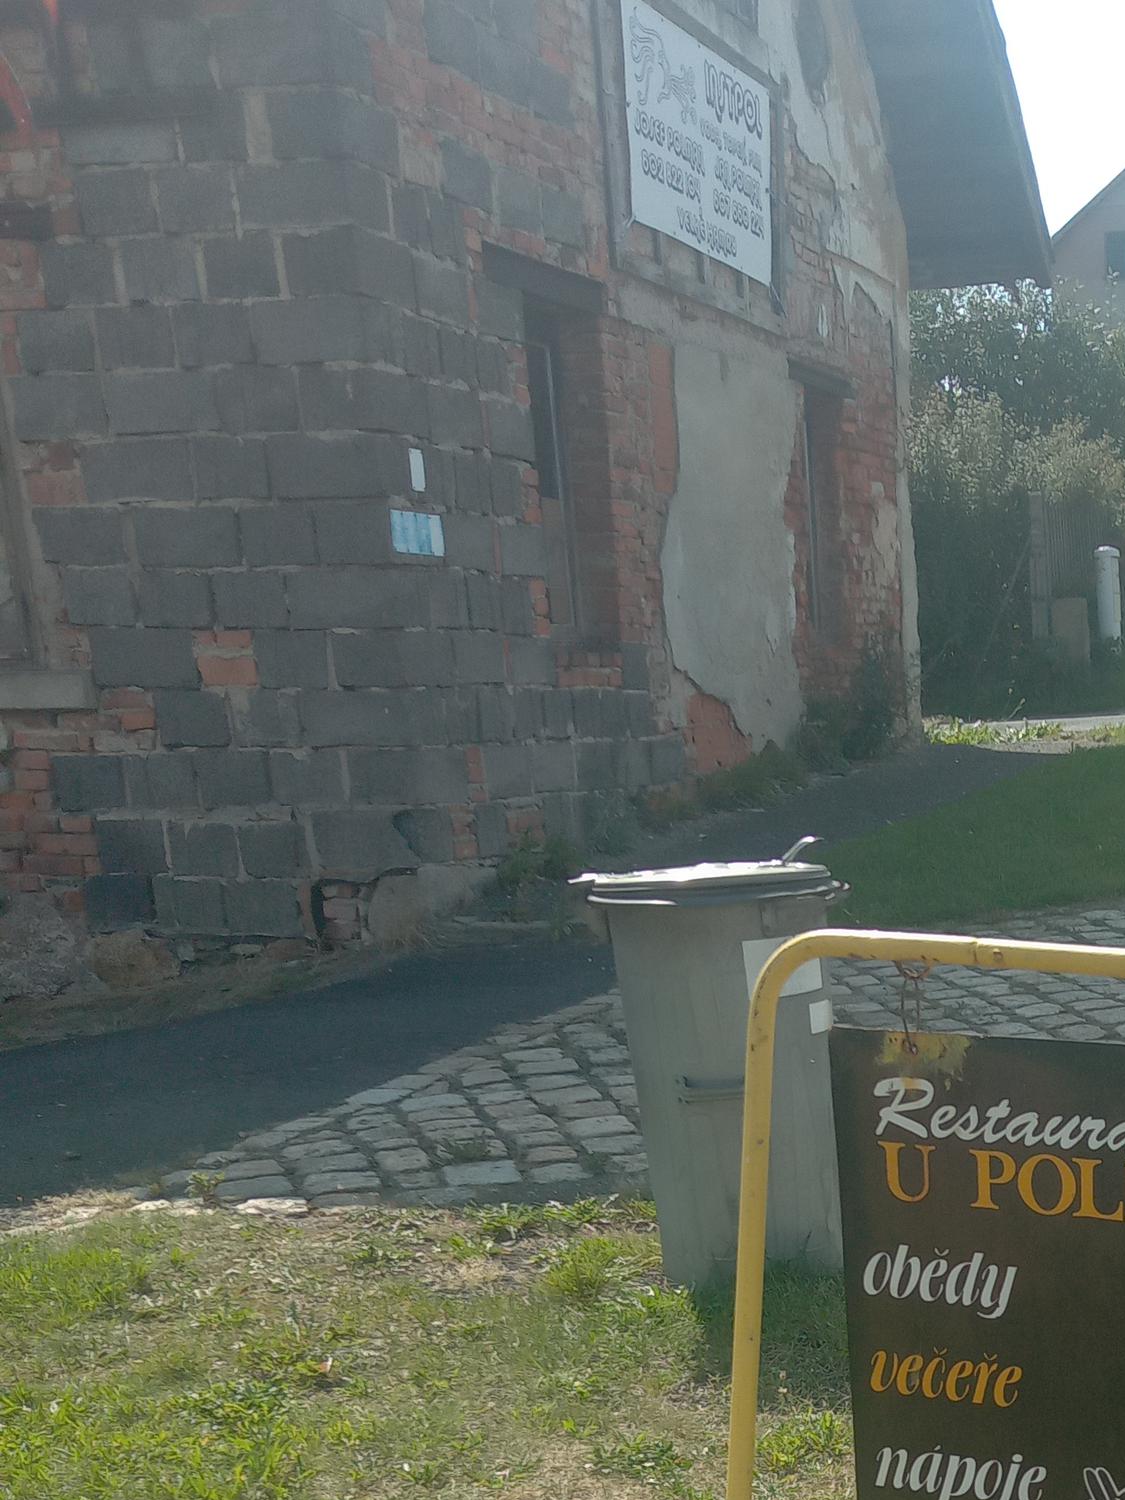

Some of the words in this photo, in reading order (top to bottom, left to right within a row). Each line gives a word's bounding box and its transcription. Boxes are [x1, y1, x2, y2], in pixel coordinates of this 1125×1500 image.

[634, 107, 665, 147] JOSEF
[641, 148, 665, 184] 602
[877, 1141, 936, 1203] U
[862, 1244, 1018, 1319] obědy
[869, 1346, 1023, 1408] večeře
